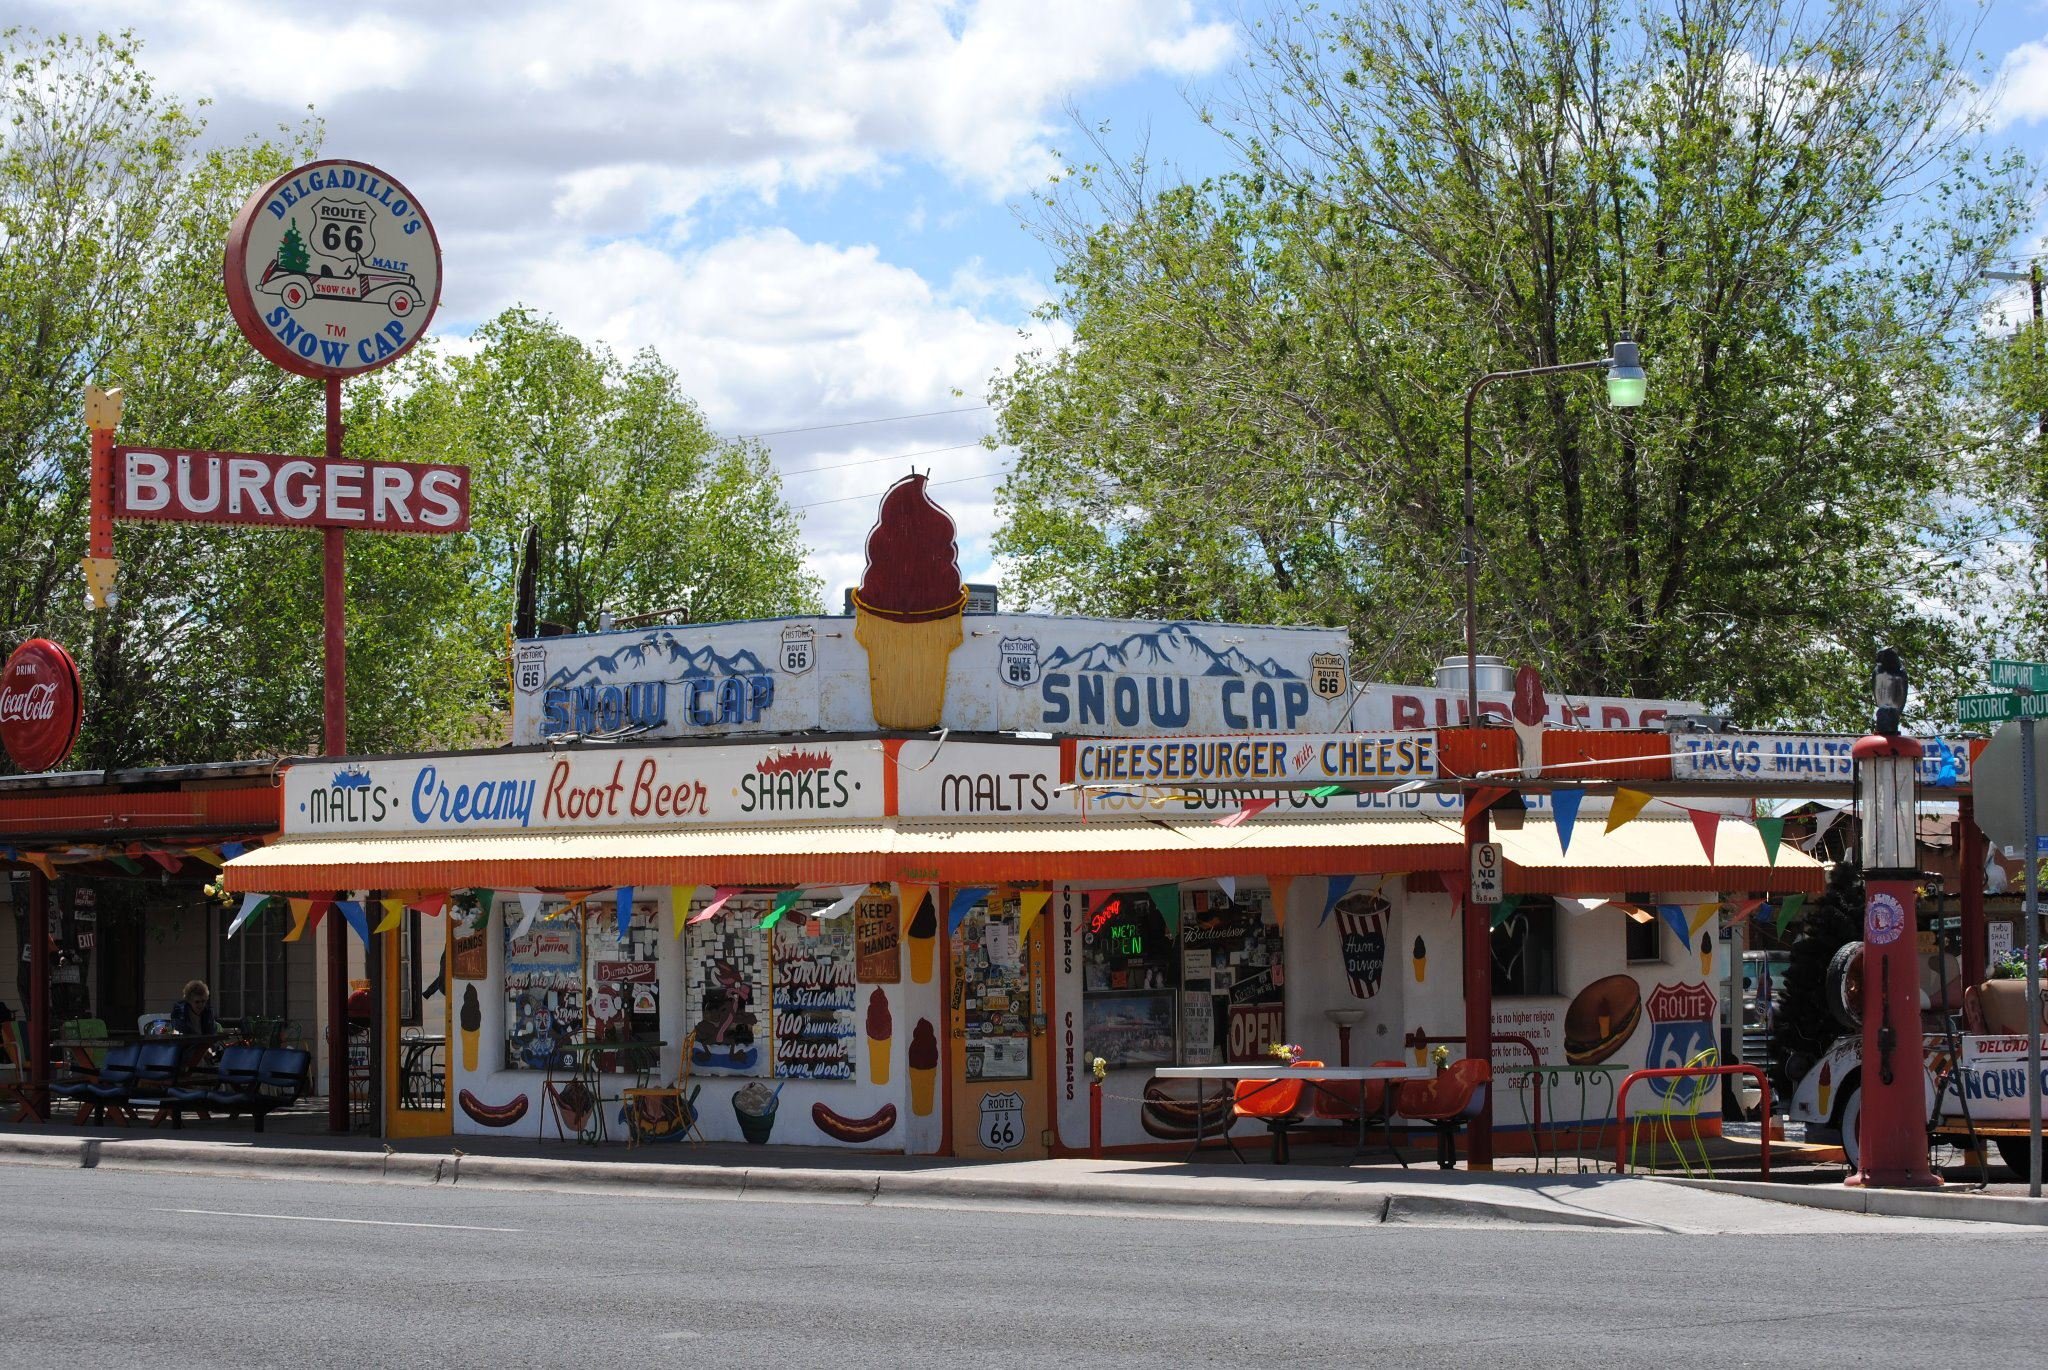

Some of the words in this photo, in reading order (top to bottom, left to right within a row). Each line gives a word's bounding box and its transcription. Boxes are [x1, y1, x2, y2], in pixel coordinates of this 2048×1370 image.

[267, 170, 422, 235] DELGADILLO'S
[321, 206, 366, 220] ROUTE
[322, 223, 363, 252] 66
[373, 257, 408, 272] MALT
[316, 284, 339, 294] SNOW
[341, 286, 357, 295] CAP
[266, 306, 349, 367] SNOW
[357, 320, 407, 364] CAP
[325, 324, 346, 337] TM
[124, 452, 462, 527] BURGERS
[521, 651, 544, 660] HISTORIC
[786, 644, 807, 652] ROUTE
[1004, 641, 1036, 652] HISTORIC
[788, 652, 806, 668] 66
[1007, 656, 1031, 665] ROUTE
[1315, 657, 1342, 666] HISTORIC
[16, 664, 37, 676] DRINK
[523, 672, 539, 687] 66
[1009, 664, 1031, 681] 66
[1317, 670, 1340, 678] ROUTE
[1992, 664, 2034, 686] LAMPORT
[1319, 678, 1339, 694] 66
[0, 682, 59, 722] Coca-Cola
[540, 681, 667, 736] SNOW
[684, 676, 775, 726] CAP
[1042, 674, 1190, 728] SNOW
[1222, 679, 1309, 729] CAP
[1958, 697, 2010, 719] HISTORIC
[1078, 741, 1287, 781] CHEESEBURGER
[1292, 744, 1316, 775] With
[1320, 737, 1435, 777] CHEESE
[1687, 740, 1761, 774] TACOS
[1775, 741, 1850, 774] MALTS
[310, 786, 388, 824] MALTS
[411, 766, 536, 828] Creamy
[542, 759, 624, 820] Root
[630, 758, 710, 817] Beer
[740, 769, 849, 812] SHAKES
[940, 773, 1048, 812] MALTS
[1478, 869, 1495, 878] NO
[860, 903, 892, 918] KEEP
[858, 921, 883, 939] FEET
[1063, 885, 1072, 974] CONES
[1183, 924, 1247, 943] Budweiser
[78, 934, 95, 948] EXIT
[457, 935, 483, 954] HANDS
[864, 934, 897, 955] HANDS
[780, 961, 856, 987] SURVIVIN
[1659, 995, 1706, 1018] ROUTE
[1496, 1012, 1502, 1024] is
[1503, 1014, 1512, 1024] no
[1512, 1011, 1532, 1025] higher
[1533, 1010, 1555, 1024] religion
[1231, 1012, 1282, 1057] OPEN
[1543, 1027, 1551, 1039] To
[779, 1040, 847, 1059] WELCOME
[1065, 1011, 1074, 1101] CONES
[1503, 1045, 1512, 1057] for
[1512, 1045, 1521, 1057] the
[1660, 1031, 1708, 1083] 66
[988, 1098, 1014, 1109] ROUTE
[990, 1122, 1014, 1144] 66
